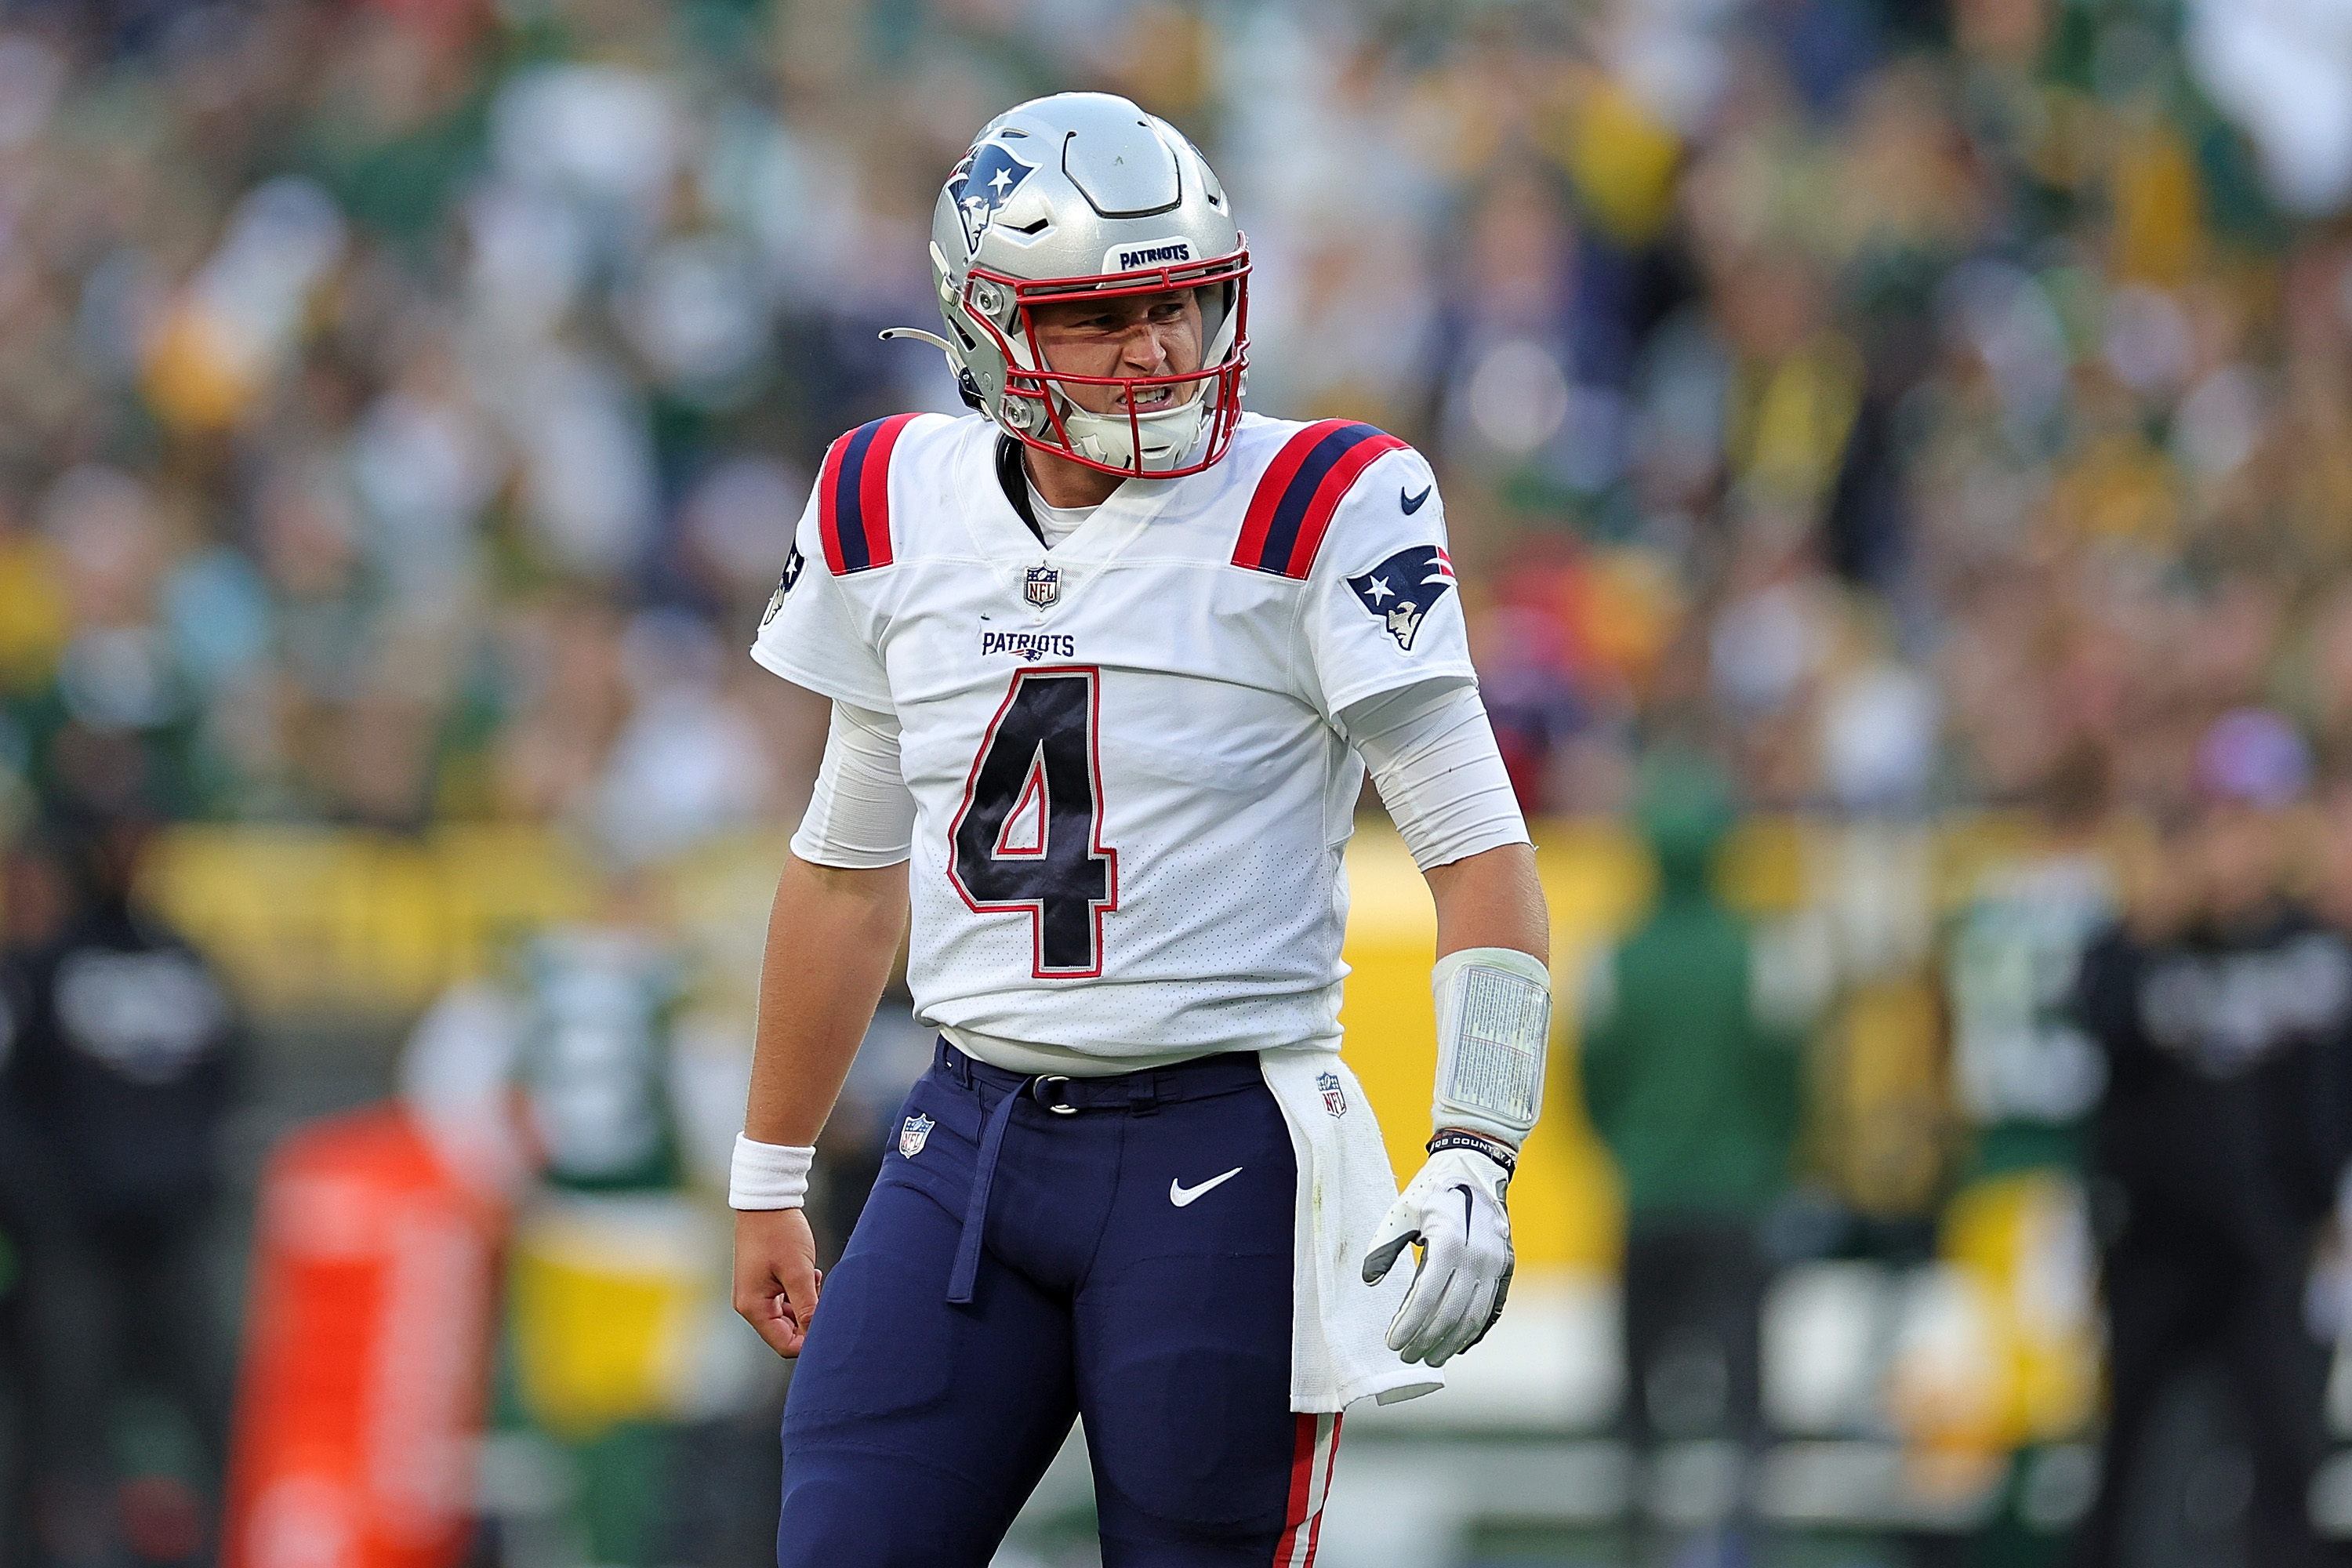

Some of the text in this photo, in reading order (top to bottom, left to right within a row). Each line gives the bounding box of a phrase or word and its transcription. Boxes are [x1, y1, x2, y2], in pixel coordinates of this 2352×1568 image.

[1120, 244, 1189, 270] PATRIOTS
[1029, 583, 1054, 601] NFL
[982, 632, 1074, 657] PATRIOTS
[946, 665, 1118, 978] 4
[1322, 1091, 1346, 1114] NFL
[902, 1133, 920, 1151] NFL
[1453, 1138, 1505, 1160] COUNTRY
